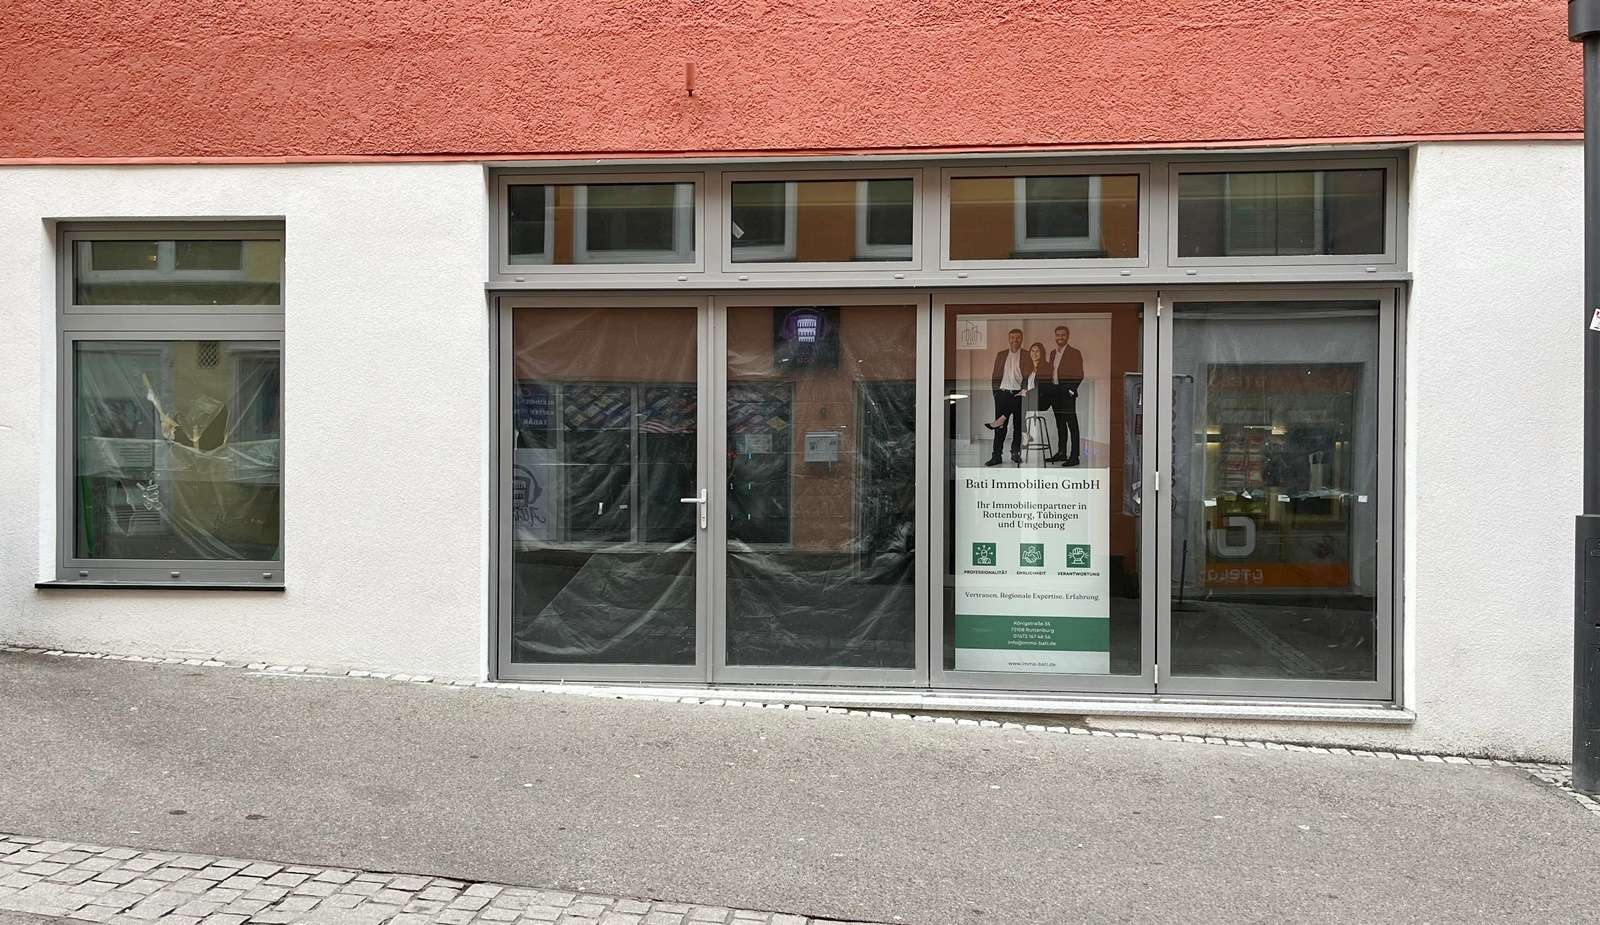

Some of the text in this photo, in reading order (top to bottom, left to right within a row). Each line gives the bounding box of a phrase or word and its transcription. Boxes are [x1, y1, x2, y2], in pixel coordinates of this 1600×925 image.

[966, 479, 1100, 490] Bati Immobilien GmbH
[976, 501, 1087, 511] Ihr Immobilienpartner in
[983, 511, 1079, 520] Rottenburg, Tübingen
[998, 520, 1065, 530] und Umgebung
[965, 591, 1101, 602] Vertrauen. Regionale Expertise. Erfahrung.
